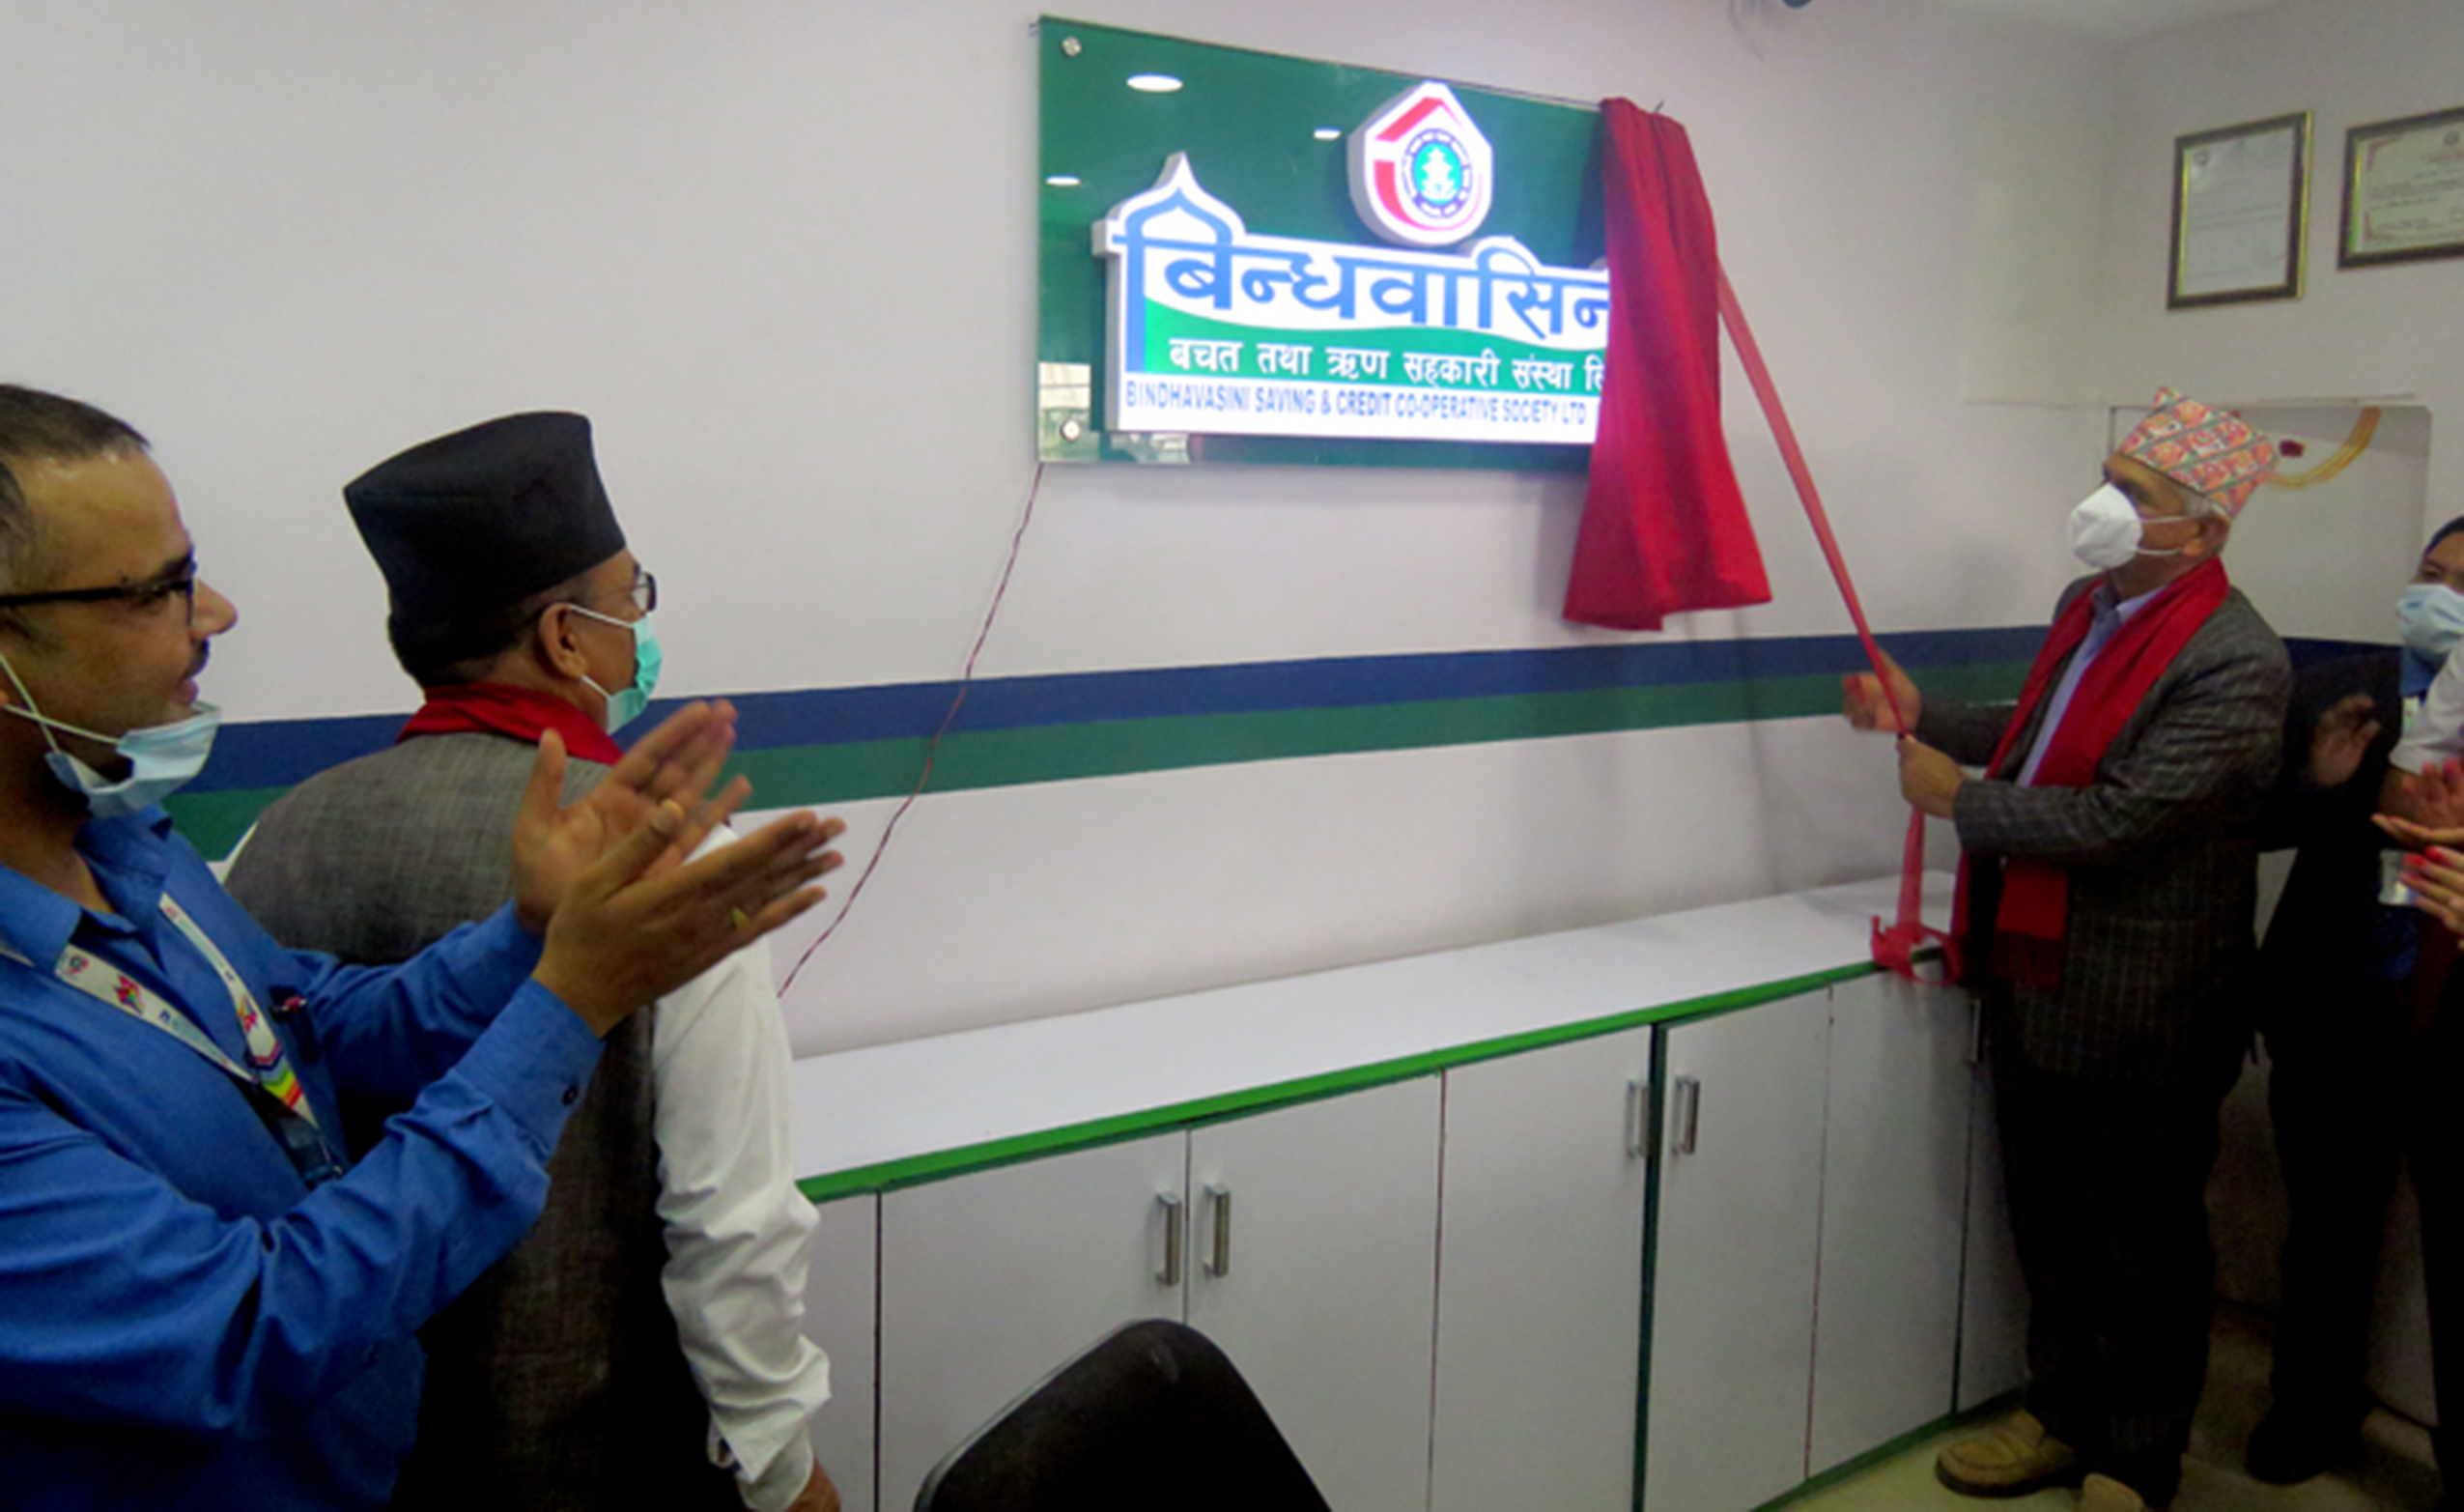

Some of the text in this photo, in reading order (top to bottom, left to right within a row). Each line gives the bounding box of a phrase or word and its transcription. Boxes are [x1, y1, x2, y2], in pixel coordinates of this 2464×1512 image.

[1169, 337, 1244, 373] बचत
[1257, 343, 1313, 376] तथा
[1325, 347, 1390, 380] ऋण
[1402, 348, 1501, 388] सहकारी
[1512, 354, 1574, 390] संस्था
[1126, 380, 1251, 412] BINDHAVASINI
[1256, 386, 1316, 414] SAVING
[1320, 389, 1331, 415] &
[1336, 389, 1392, 418] CREDIT
[1395, 392, 1498, 422] CO-OPERATIVE
[1503, 398, 1558, 423] SOCIETY
